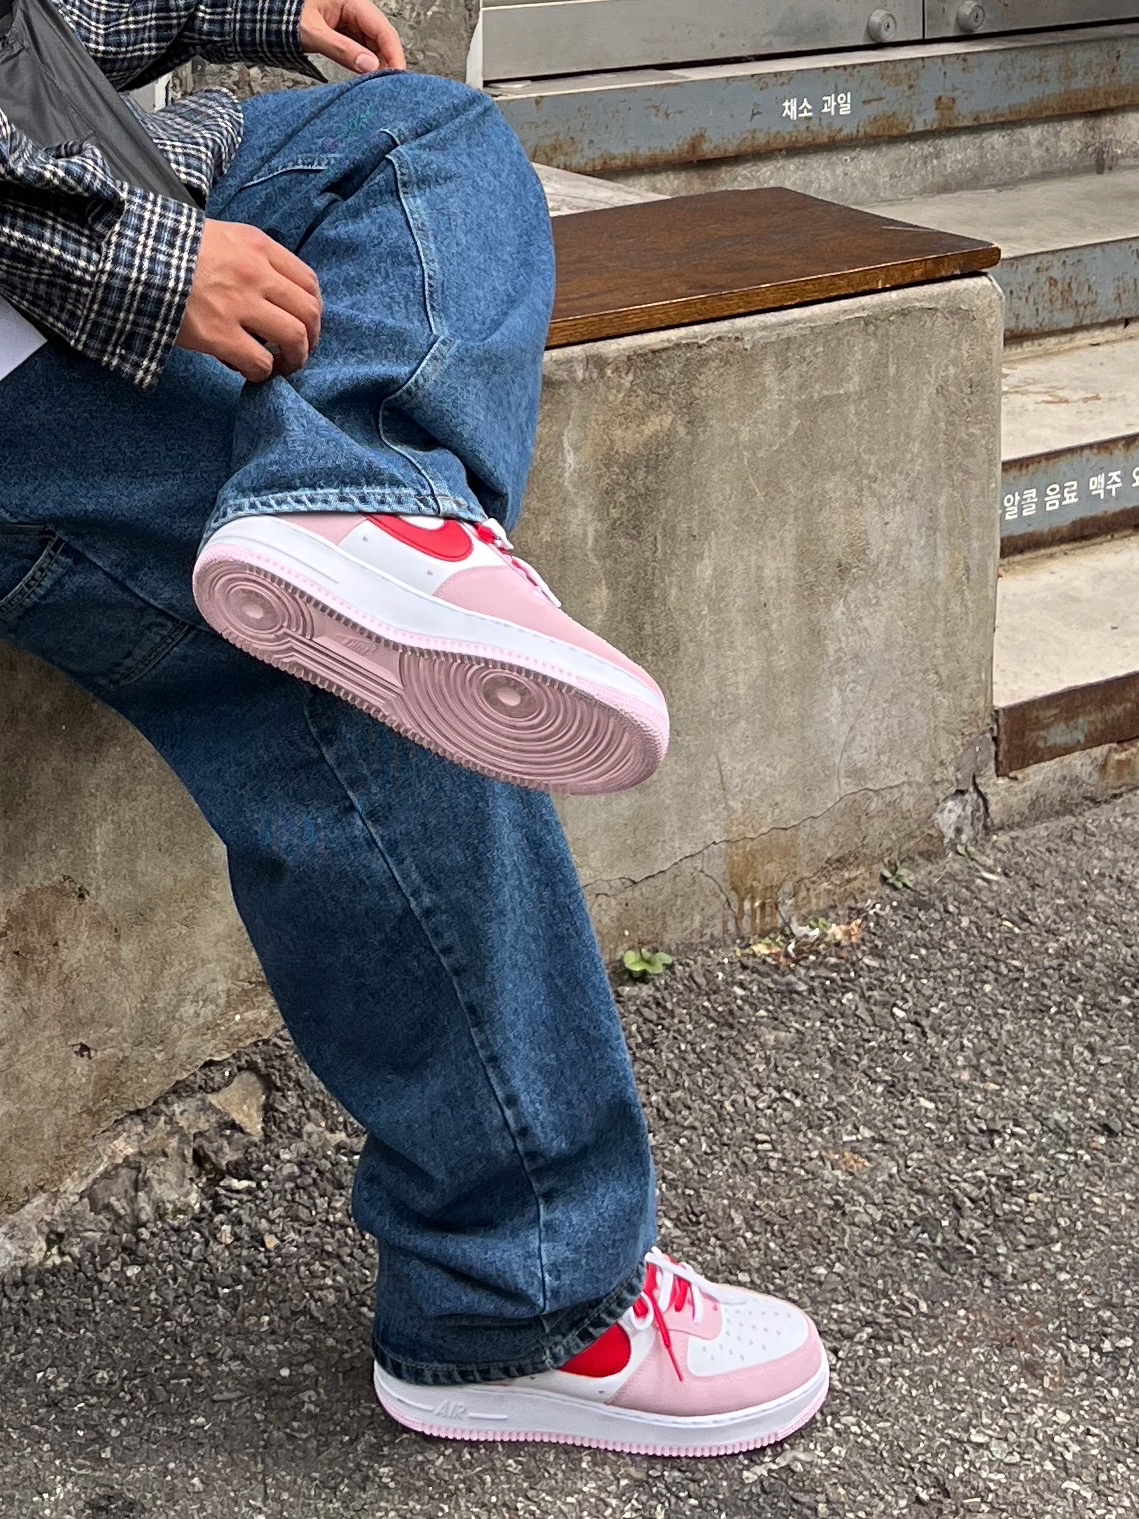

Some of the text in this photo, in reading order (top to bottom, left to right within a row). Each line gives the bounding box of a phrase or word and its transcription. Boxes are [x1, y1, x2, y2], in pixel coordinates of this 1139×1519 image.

[782, 92, 852, 120] 채소 과일
[998, 488, 1038, 520] 알콜
[1044, 480, 1078, 512] 음료
[1089, 470, 1123, 500] 맥주
[433, 1399, 468, 1421] AIR
